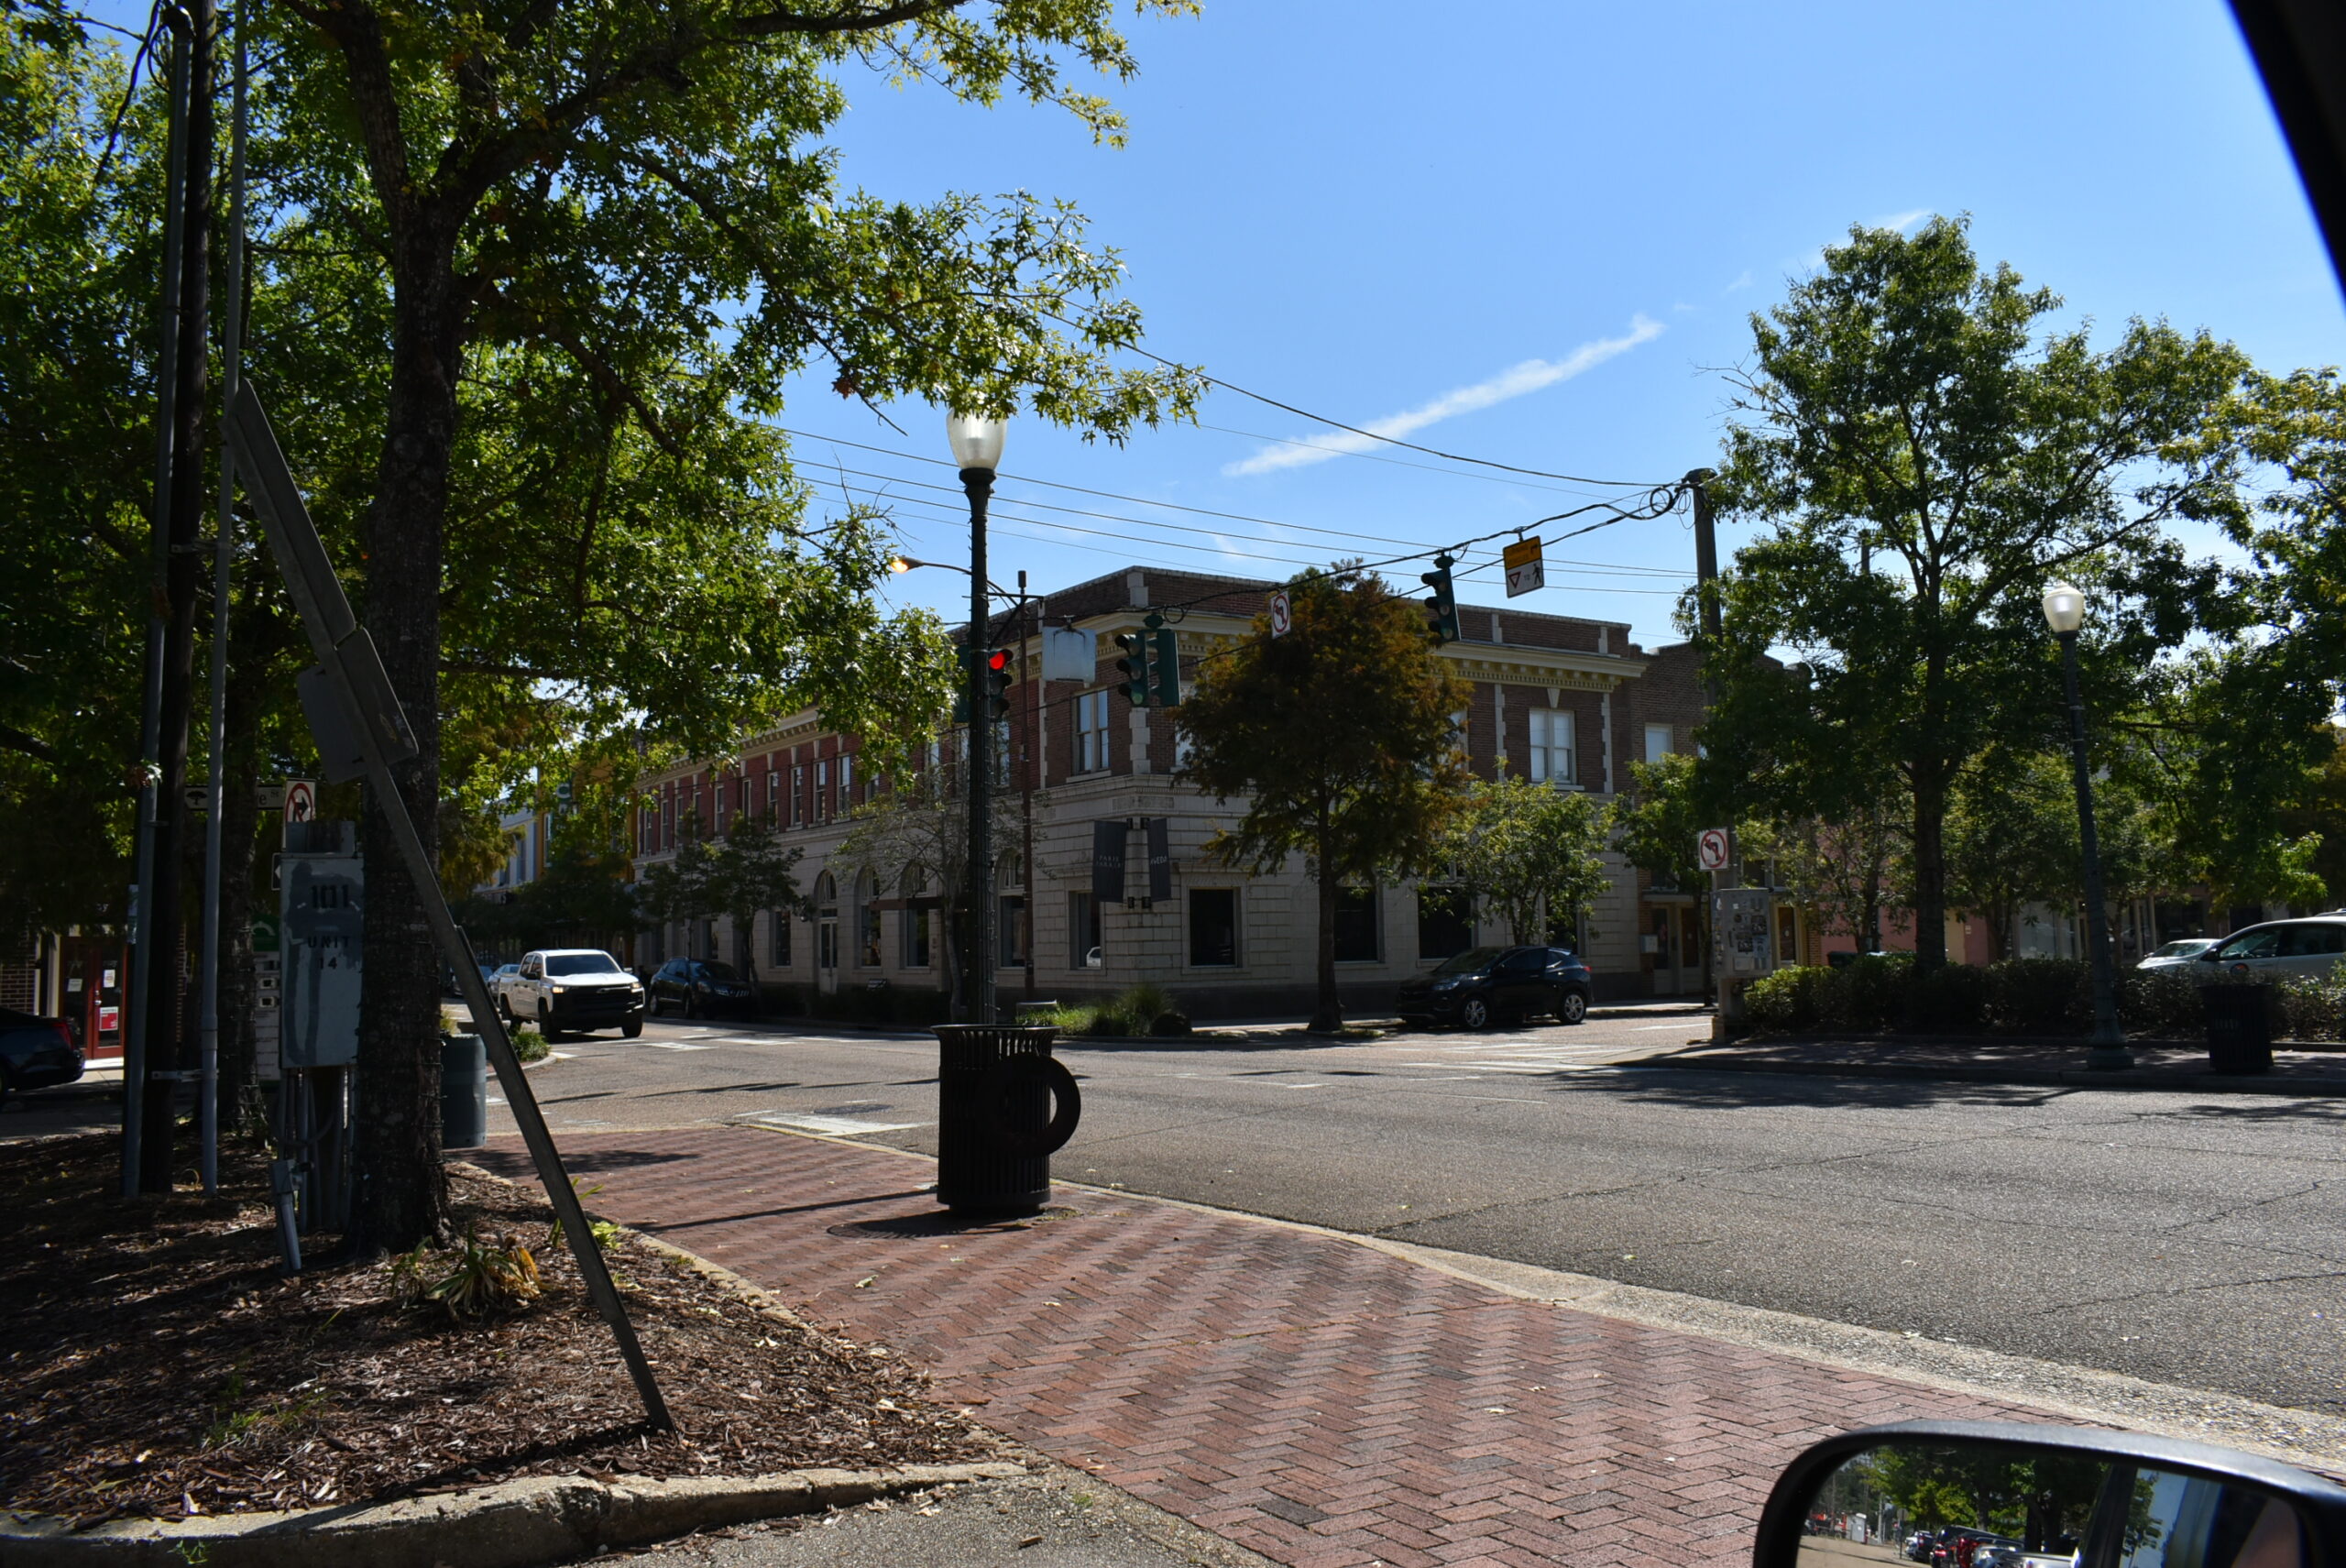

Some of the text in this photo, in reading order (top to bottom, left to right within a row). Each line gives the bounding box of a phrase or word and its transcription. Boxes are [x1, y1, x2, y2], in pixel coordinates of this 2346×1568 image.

[312, 884, 348, 908] 101
[308, 936, 350, 948] UNIT
[318, 957, 337, 970] 14
